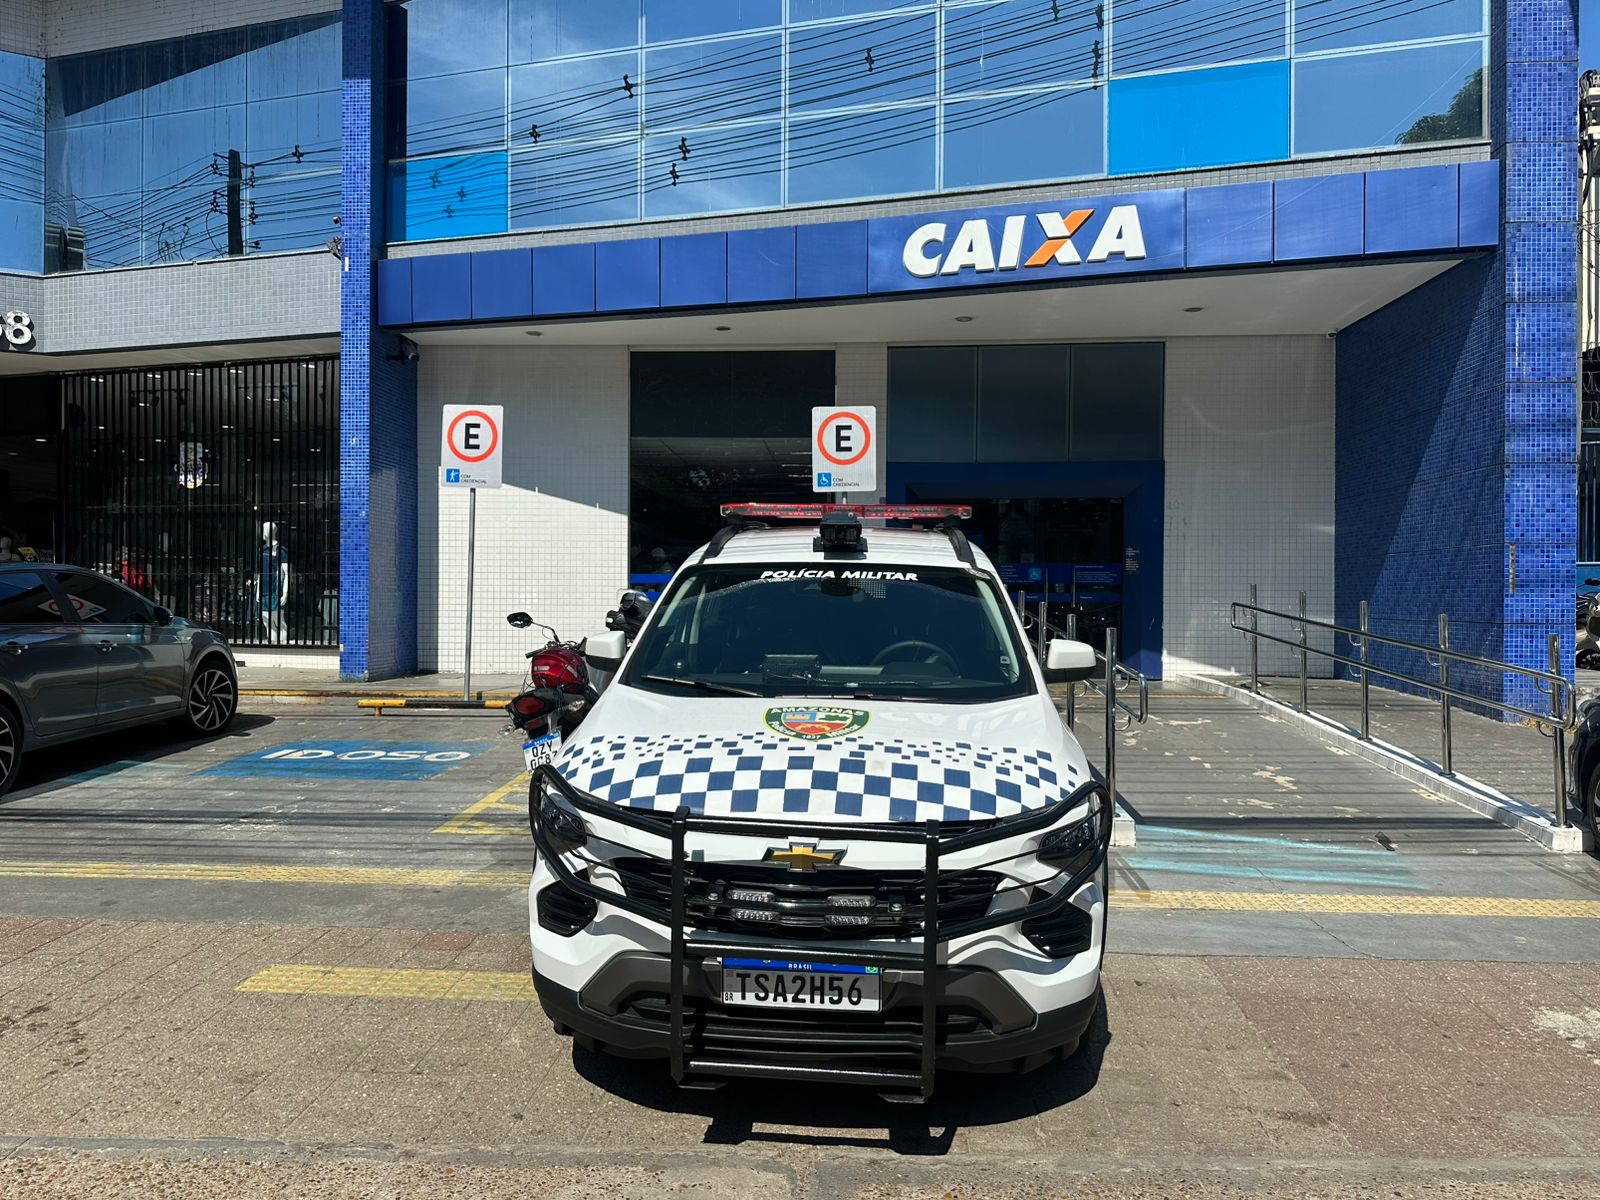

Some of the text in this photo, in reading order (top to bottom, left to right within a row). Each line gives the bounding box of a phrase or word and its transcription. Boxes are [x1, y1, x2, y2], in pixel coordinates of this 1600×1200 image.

[902, 205, 1147, 278] CAIXA
[0, 310, 32, 345] 8
[464, 423, 481, 449] E
[835, 425, 853, 452] E
[760, 568, 919, 581] POLÍCIA MILITAR
[771, 706, 865, 716] AMAZONAS
[260, 749, 471, 762] IDOSO
[788, 963, 813, 971] BRASIL
[736, 973, 862, 1006] TSA2H56
